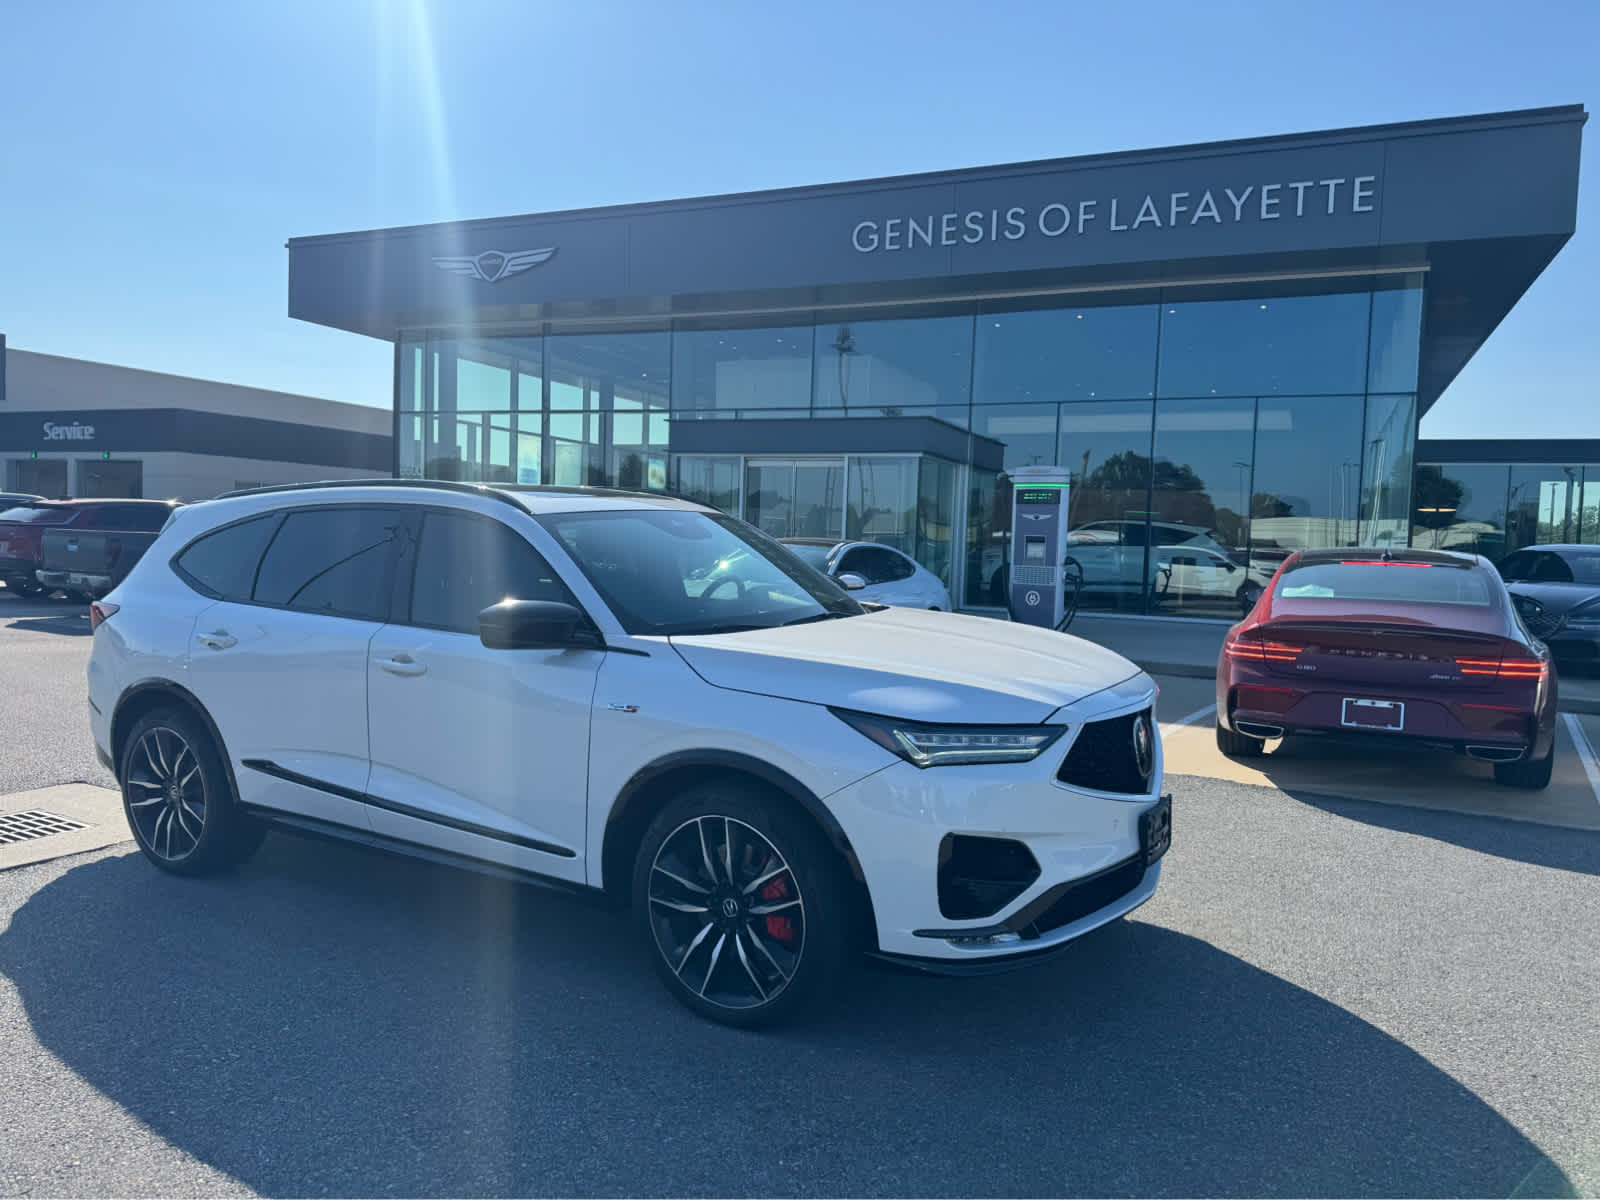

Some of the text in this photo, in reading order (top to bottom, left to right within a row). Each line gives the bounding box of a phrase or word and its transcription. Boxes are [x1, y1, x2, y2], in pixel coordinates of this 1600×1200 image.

[852, 175, 1376, 252] GENESIS OF LAFAYETTE
[43, 421, 96, 440] Service
